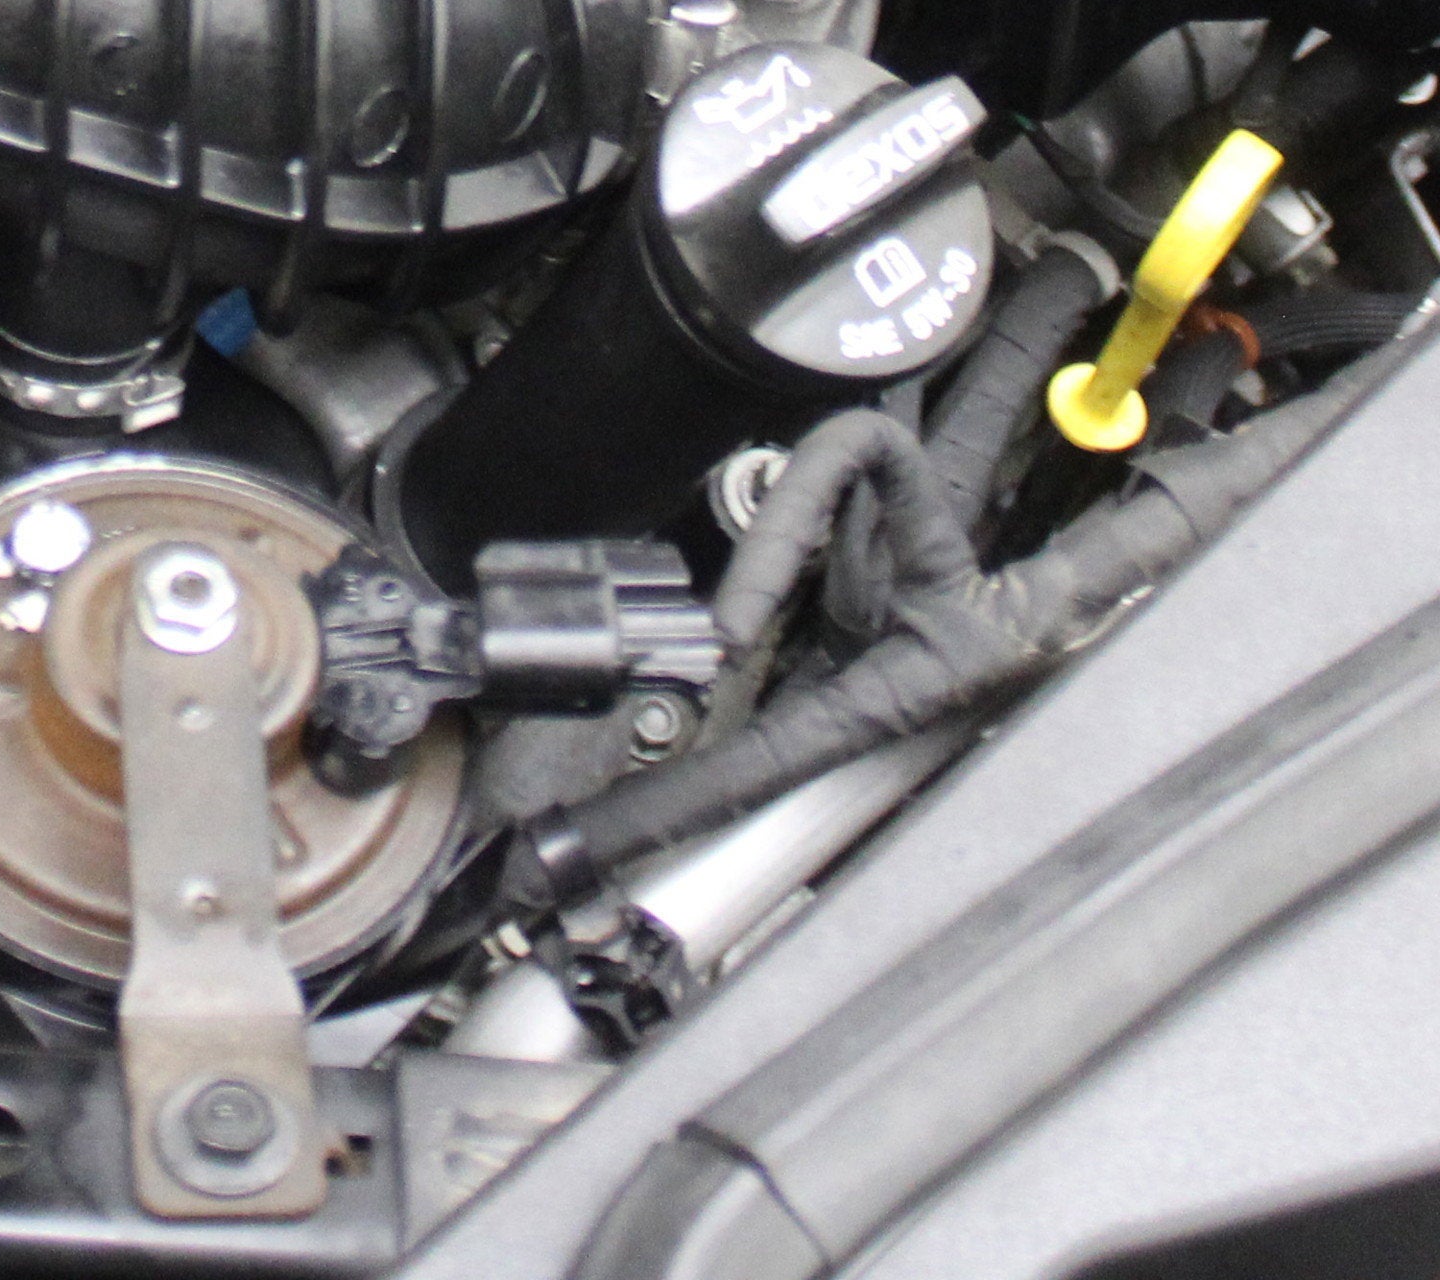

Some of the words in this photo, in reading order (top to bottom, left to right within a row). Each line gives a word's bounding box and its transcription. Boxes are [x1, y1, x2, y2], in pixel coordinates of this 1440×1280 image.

[787, 92, 970, 231] dexos
[839, 318, 904, 359] SAE
[902, 248, 978, 340] 5W-30
